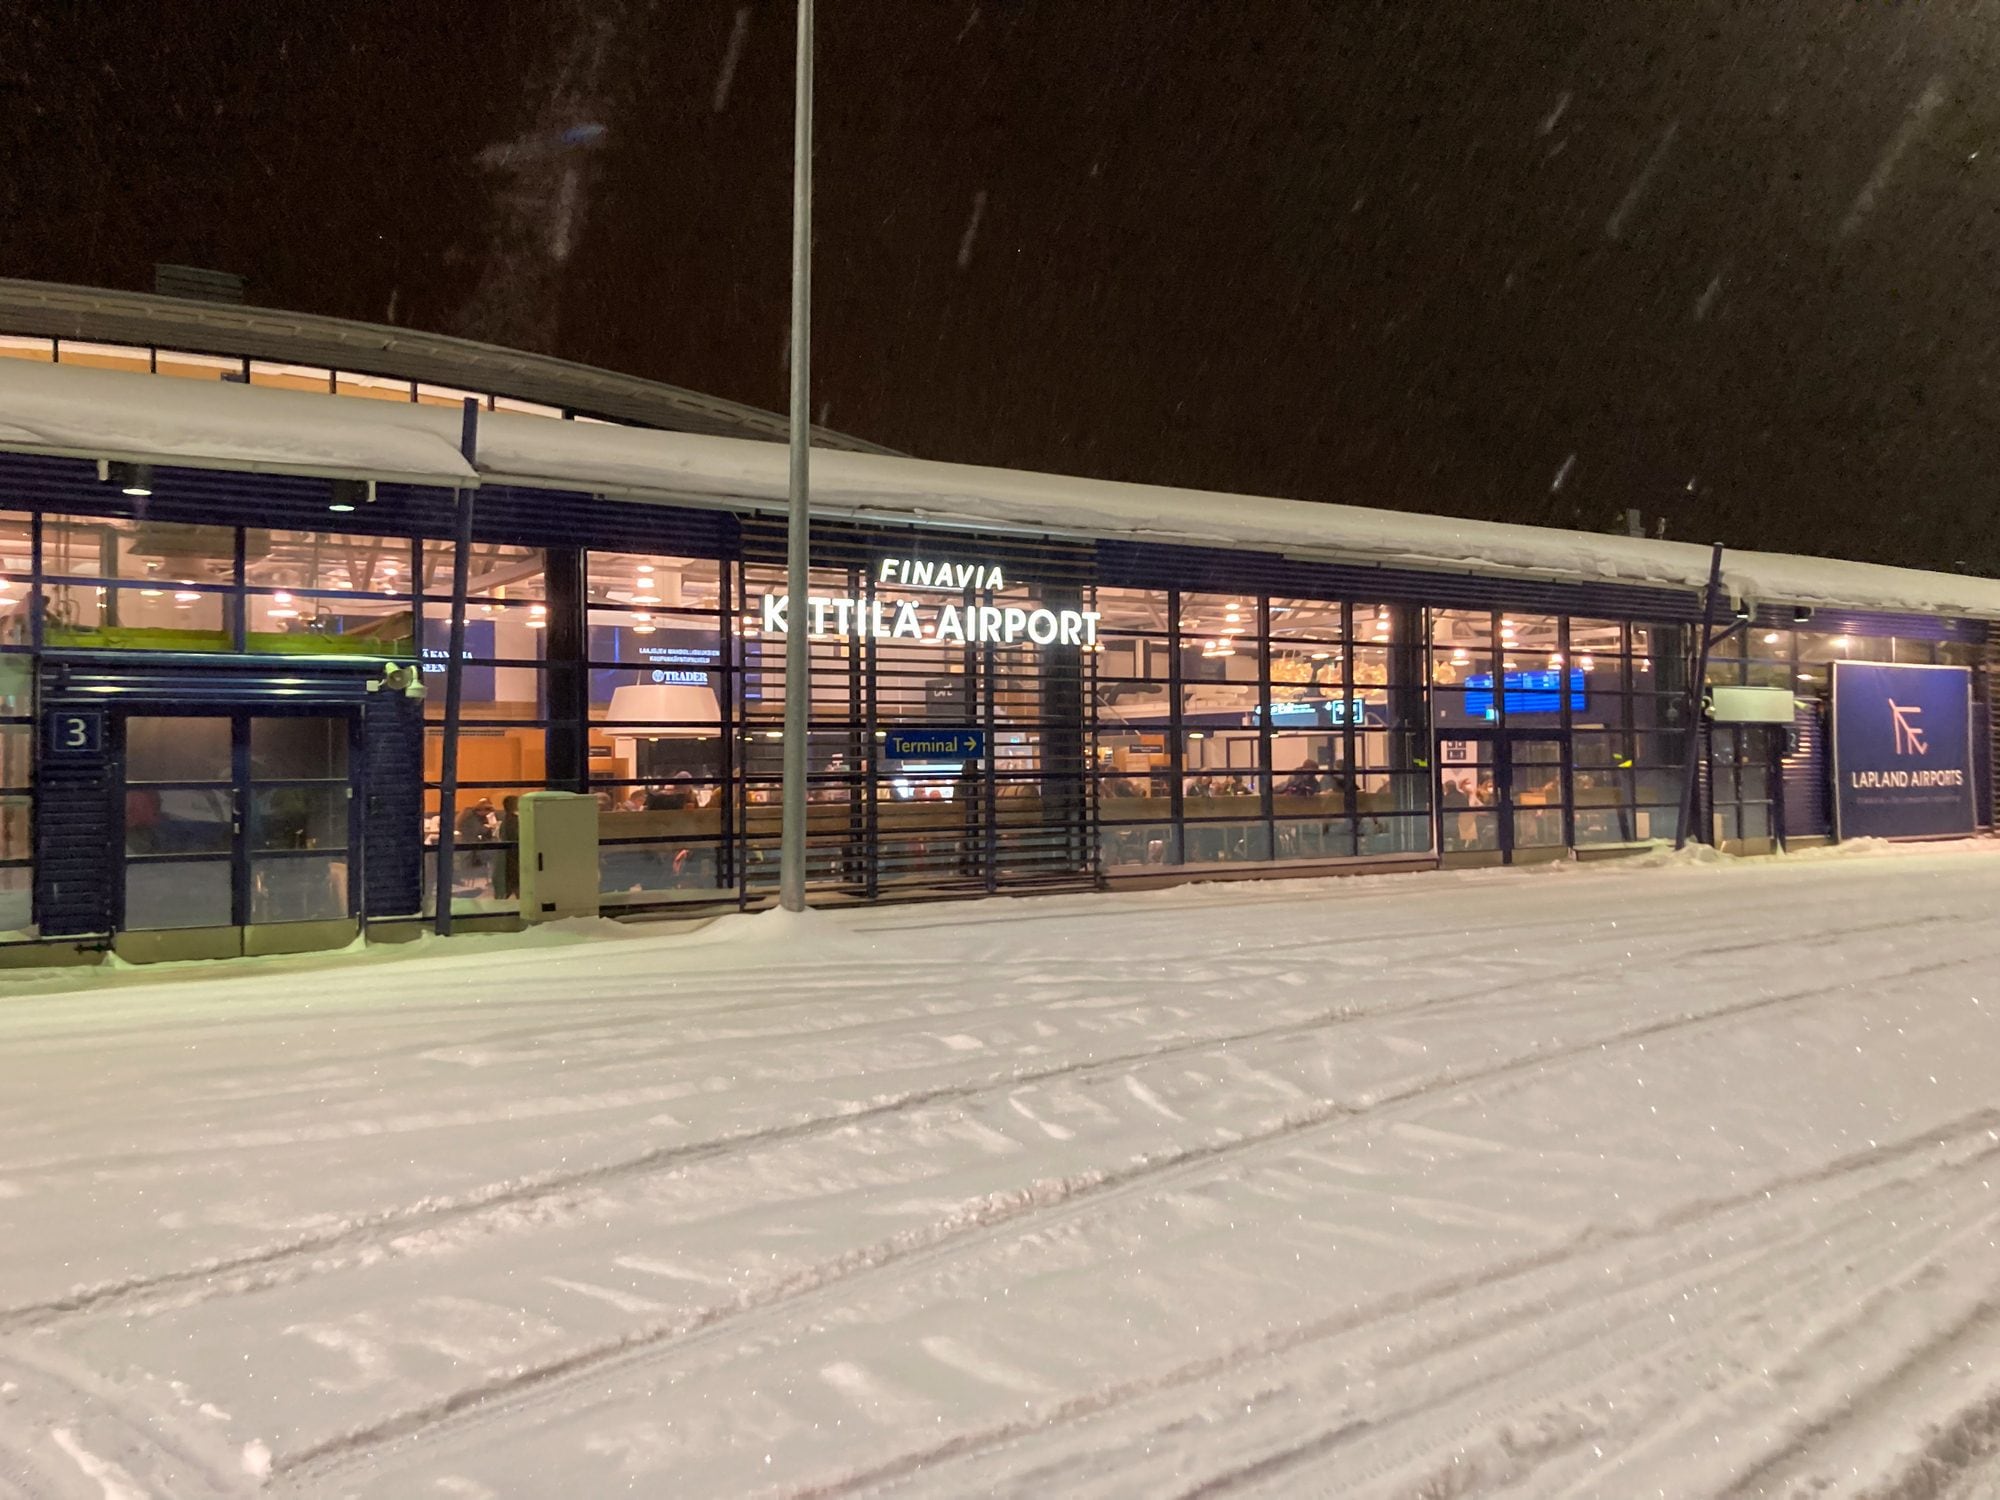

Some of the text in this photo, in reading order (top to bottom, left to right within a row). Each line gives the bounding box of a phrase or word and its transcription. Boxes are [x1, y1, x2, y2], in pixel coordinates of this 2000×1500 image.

[880, 558, 1004, 591] FINAVIA
[764, 593, 1102, 646] KTTILÄ AIRPORT
[664, 671, 708, 682] TRADER
[65, 718, 87, 747] 3
[892, 736, 958, 753] Terminal
[1852, 769, 1963, 789] LAPLAND AIRPORTS
